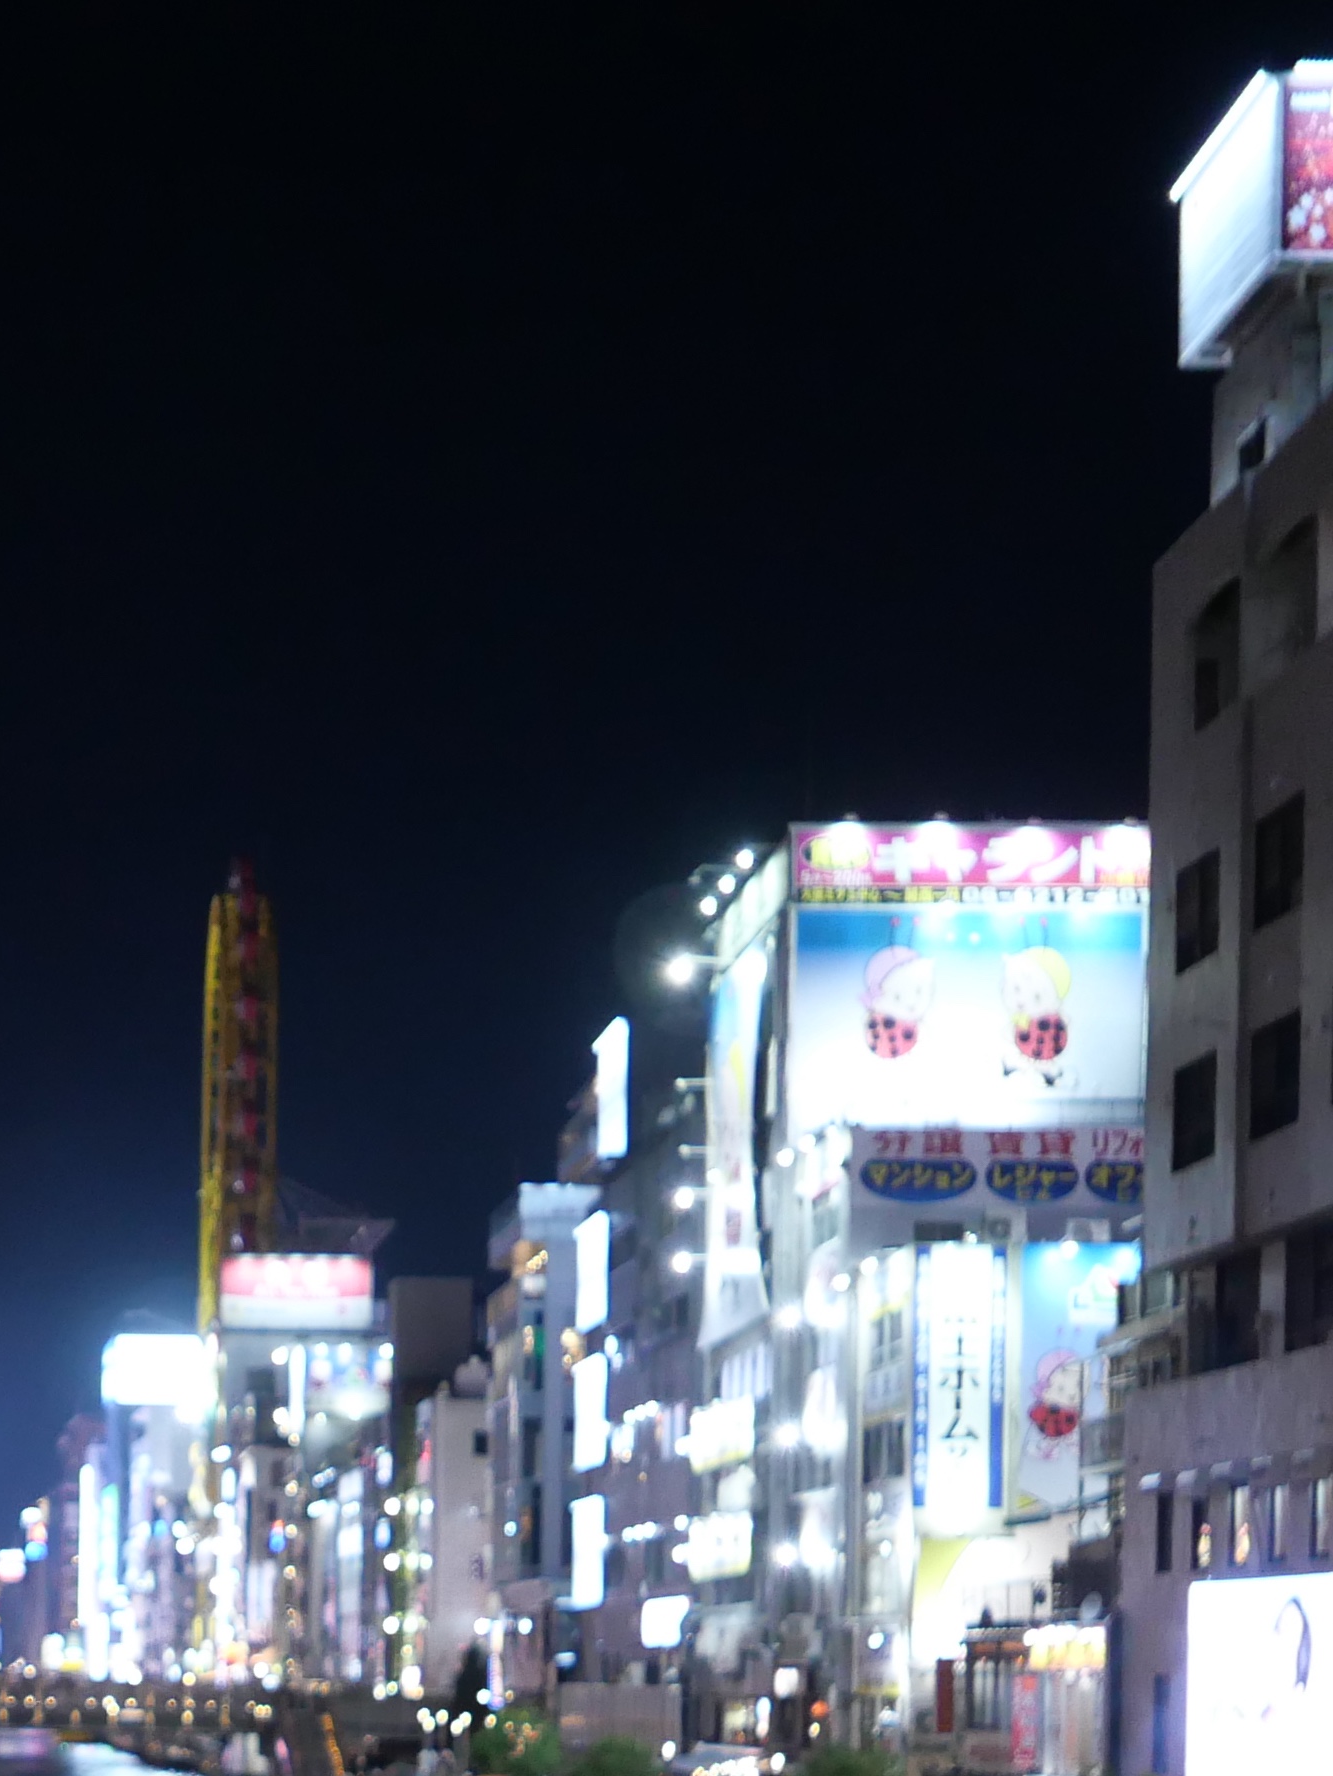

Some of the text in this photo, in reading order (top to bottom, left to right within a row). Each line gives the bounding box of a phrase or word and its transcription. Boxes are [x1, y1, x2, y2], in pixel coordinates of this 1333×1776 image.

[869, 1162, 974, 1190] マンション
[992, 1162, 1076, 1190] レジャー
